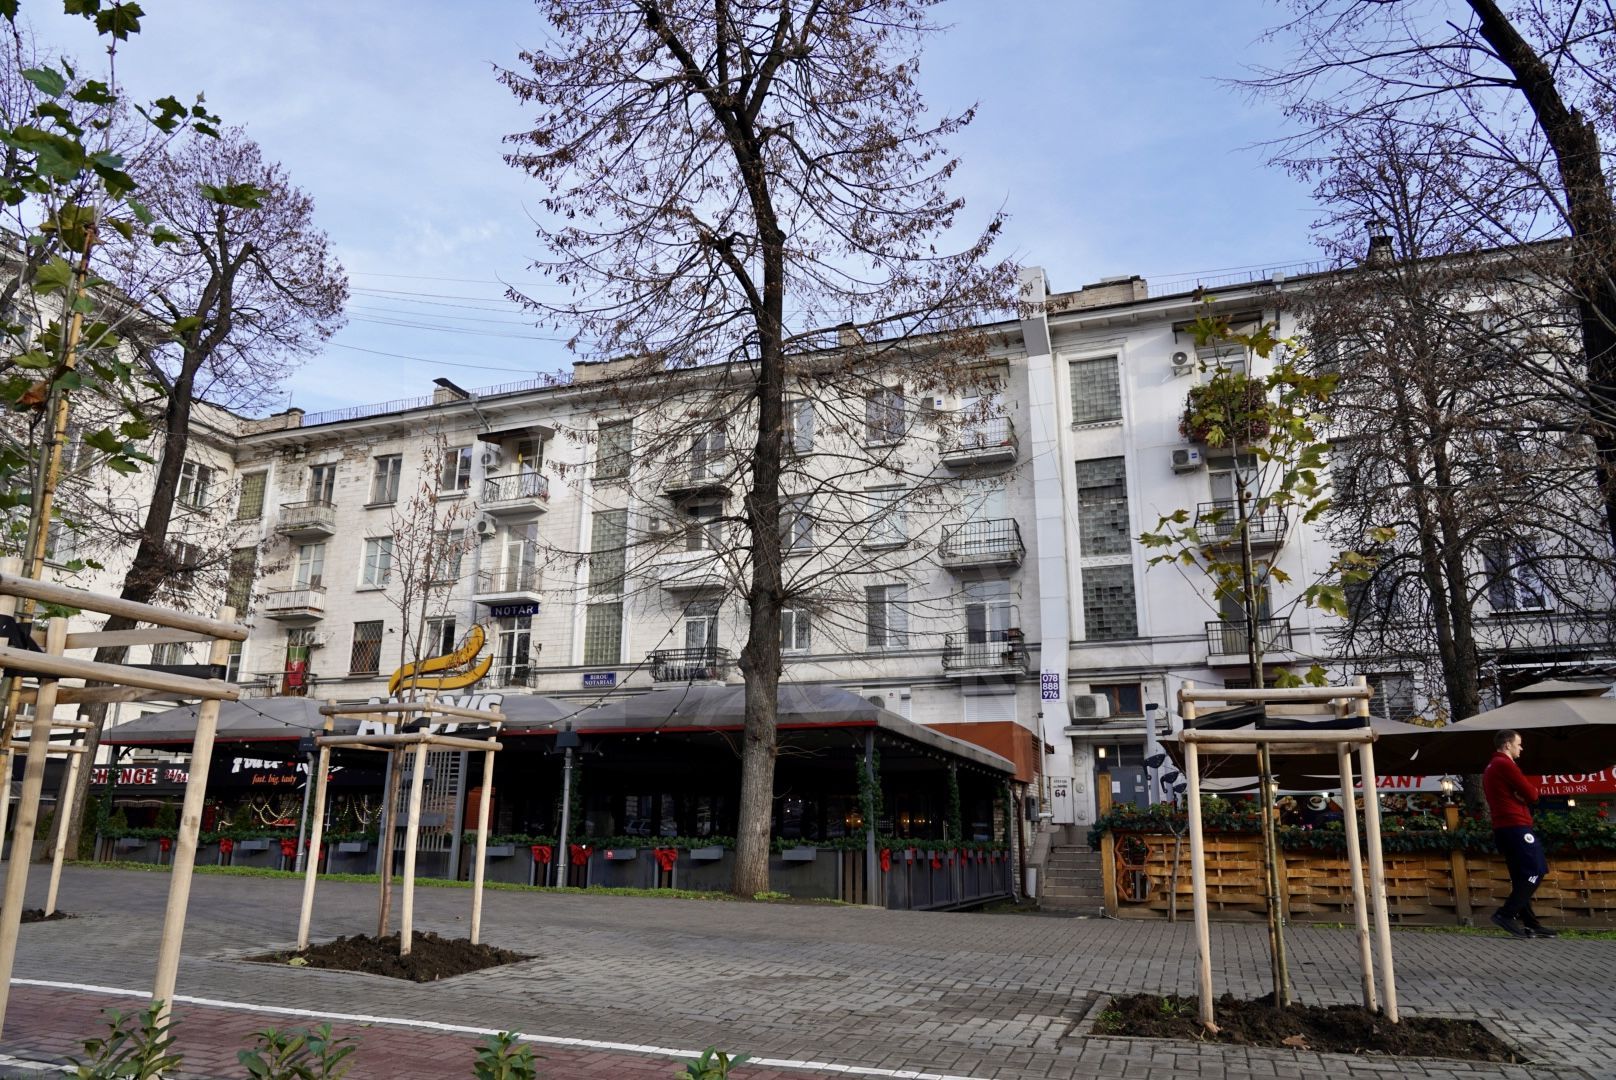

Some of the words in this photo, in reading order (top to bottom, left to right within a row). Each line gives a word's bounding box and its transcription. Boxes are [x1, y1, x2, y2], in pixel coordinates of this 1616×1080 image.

[495, 605, 534, 616] NOTAR
[1042, 674, 1058, 682] 078
[584, 679, 614, 687] NOTARIAL
[1042, 682, 1058, 690] 888
[1043, 690, 1058, 699] 976
[90, 768, 158, 784] CHNGE
[1576, 784, 1588, 793] 88
[1055, 789, 1066, 798] 64
